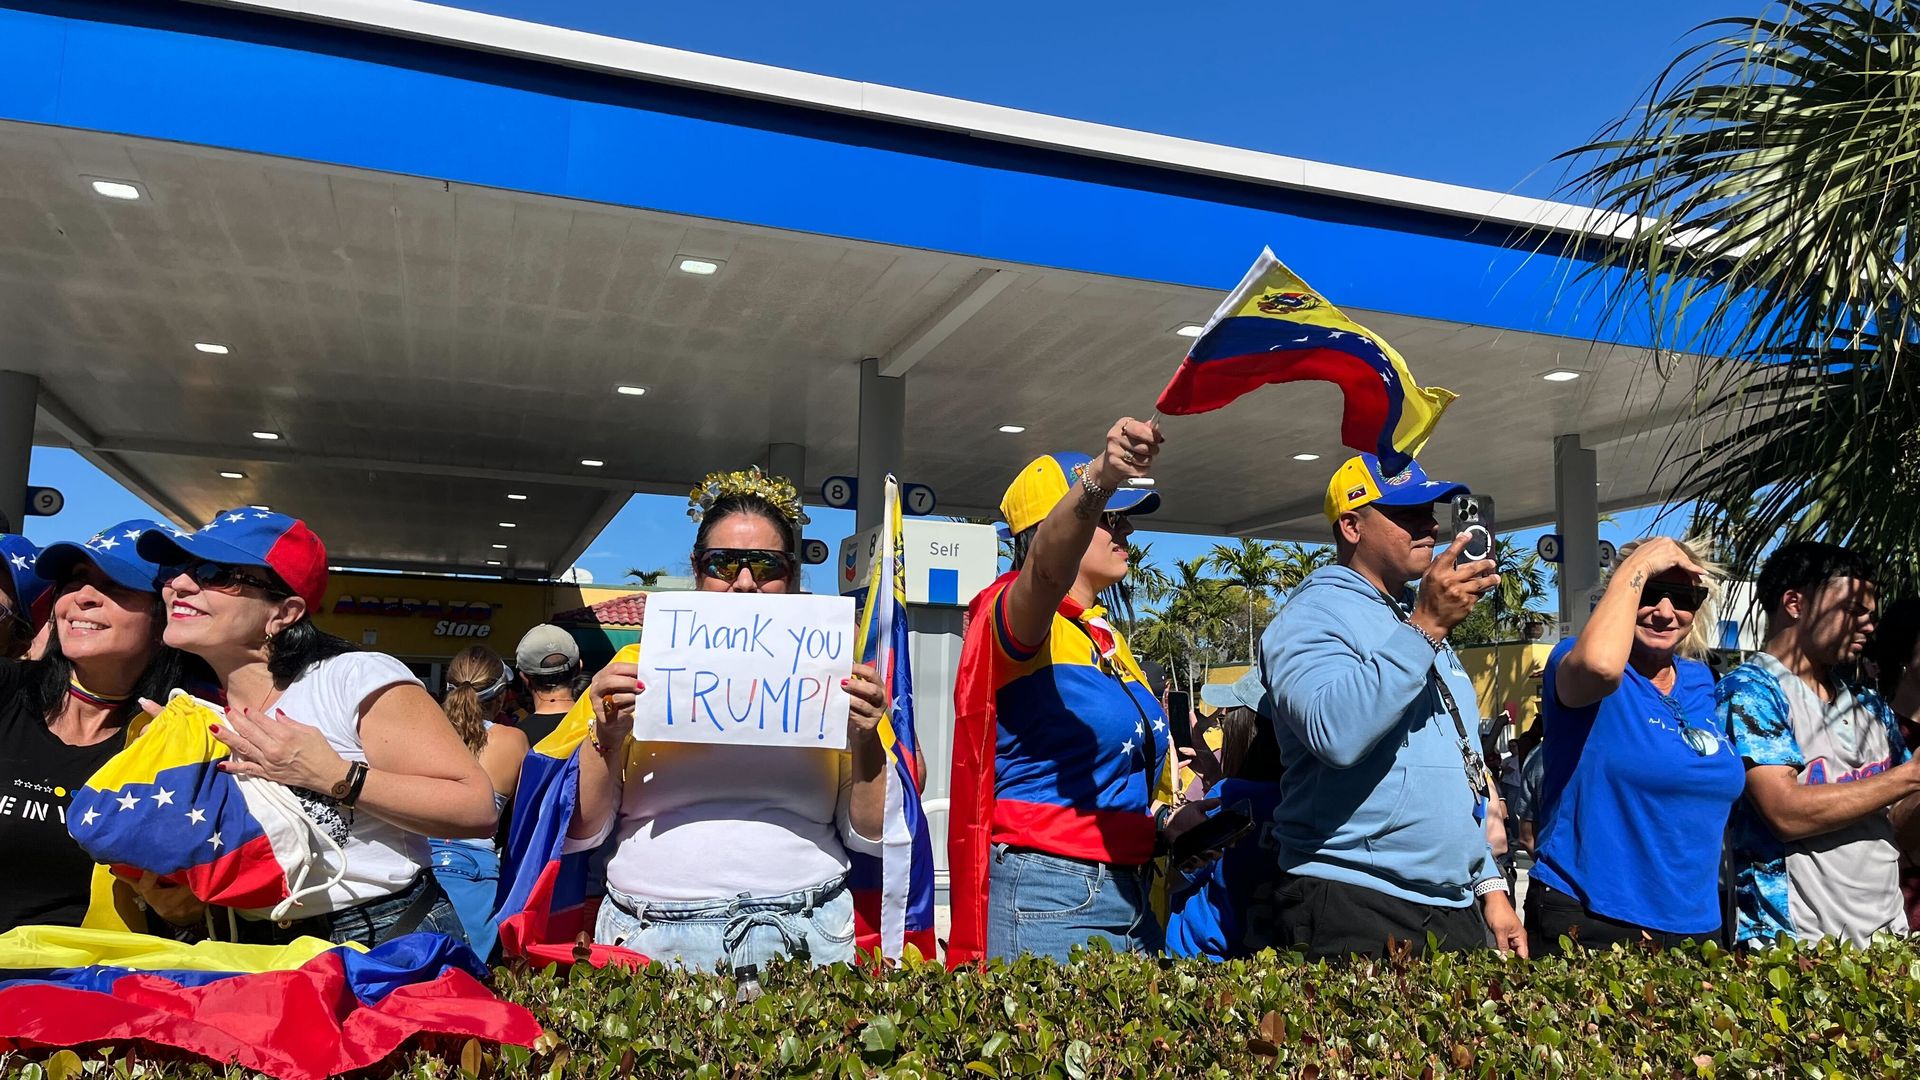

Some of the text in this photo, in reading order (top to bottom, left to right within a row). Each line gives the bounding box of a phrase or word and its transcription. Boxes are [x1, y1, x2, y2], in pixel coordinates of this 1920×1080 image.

[832, 485, 843, 499] 8
[915, 492, 926, 507] 7
[41, 494, 53, 508] 9
[812, 546, 821, 558] 5
[869, 533, 876, 557] 8
[929, 541, 960, 557] Self
[1544, 541, 1553, 554] 4
[1601, 547, 1609, 560] 3
[433, 620, 491, 637] Store
[659, 609, 841, 675] Thank you
[654, 667, 831, 740] TRUMP!
[22, 800, 49, 821] IN
